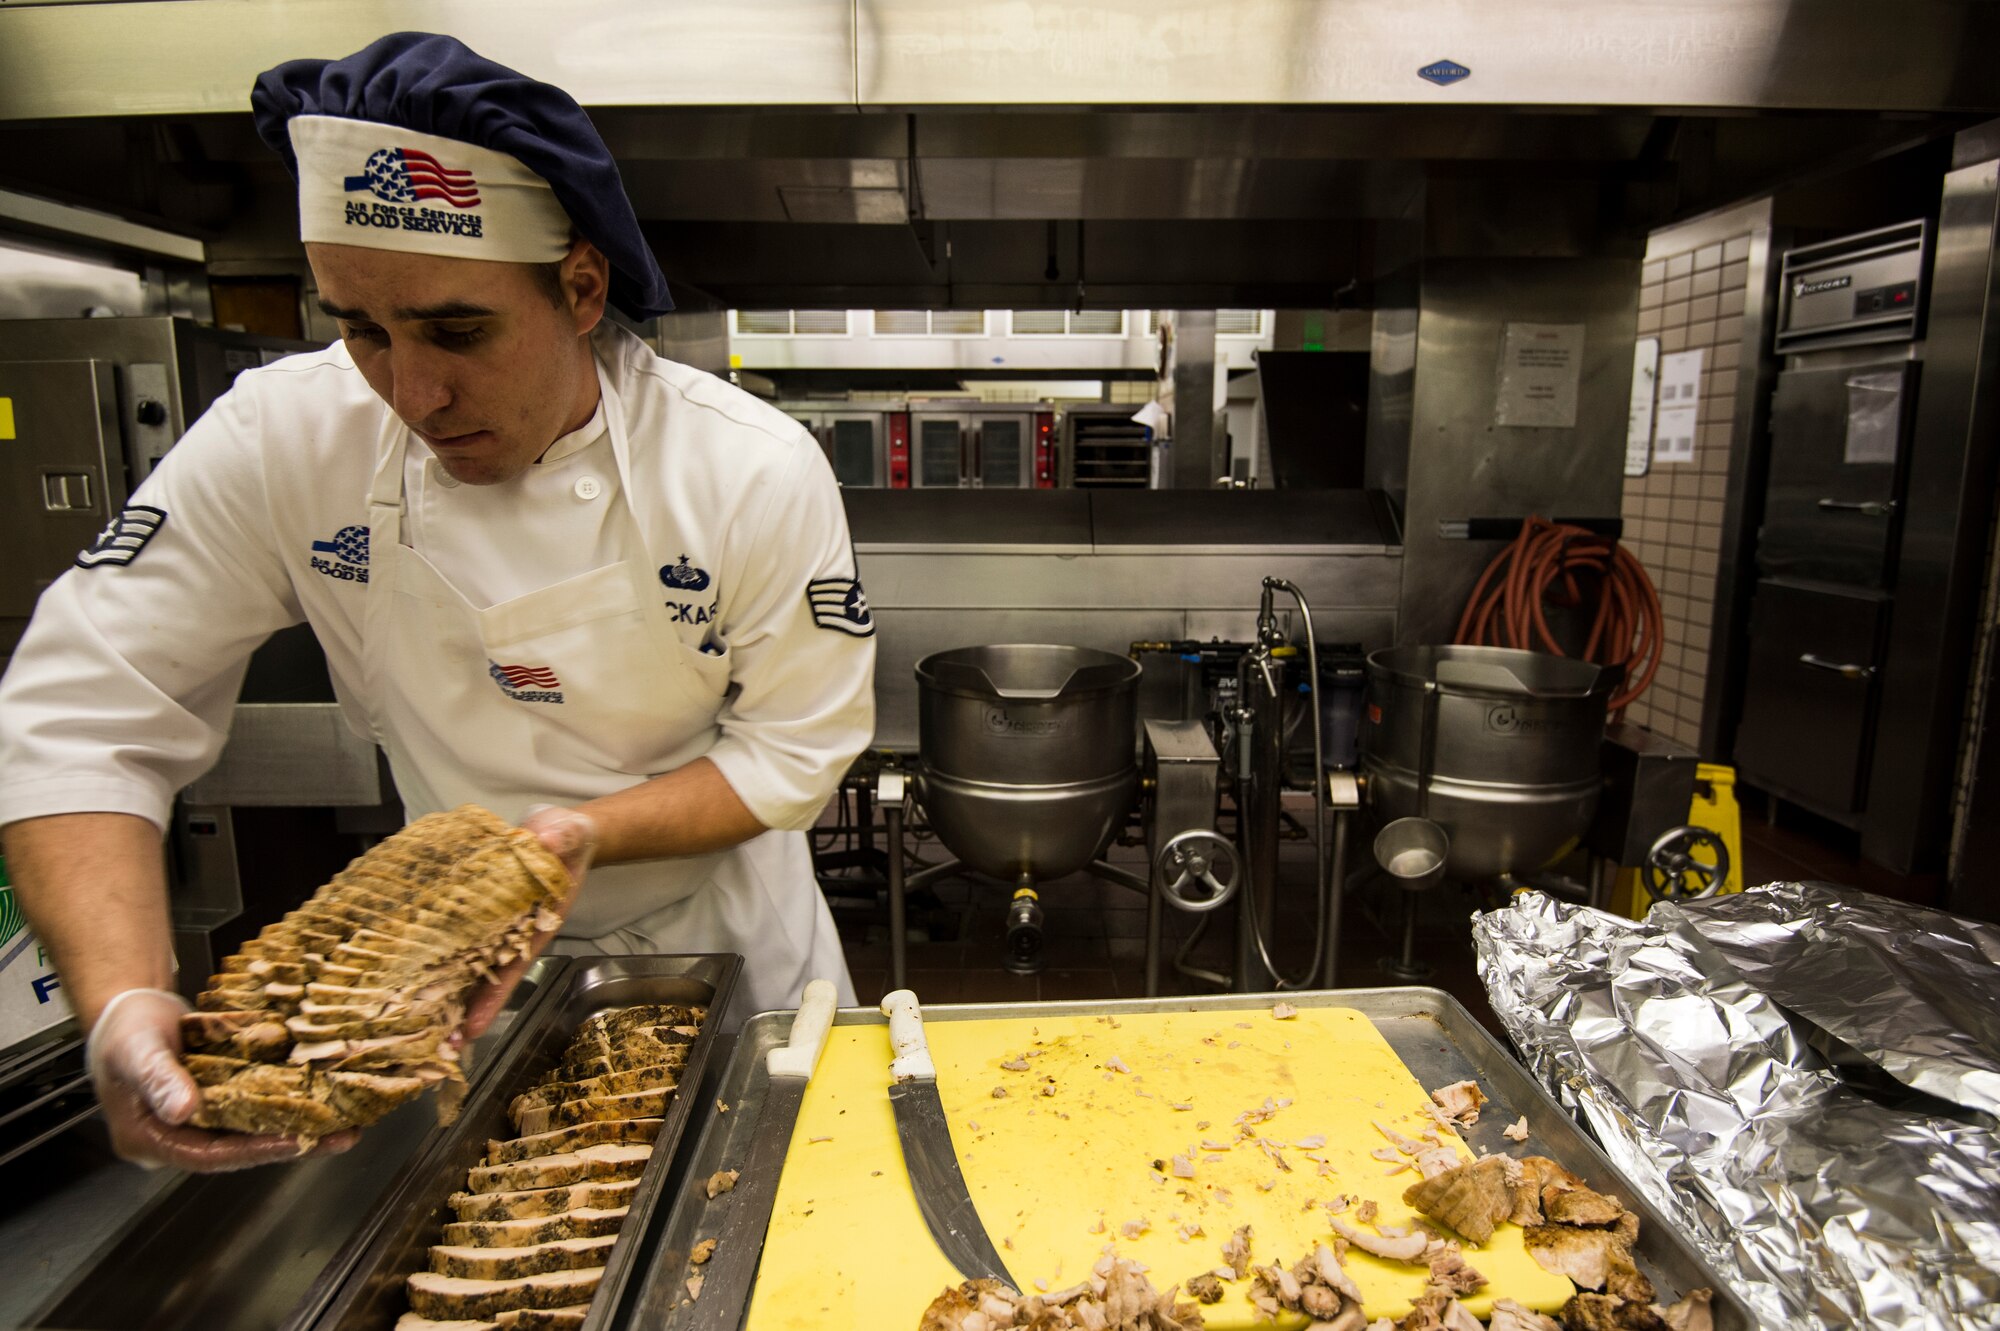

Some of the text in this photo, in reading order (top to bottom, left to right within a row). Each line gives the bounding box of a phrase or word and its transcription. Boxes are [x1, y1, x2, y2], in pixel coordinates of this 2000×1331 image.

[345, 201, 482, 224] AIR FORCE SERVICES
[345, 210, 483, 238] FOOD SERVICE
